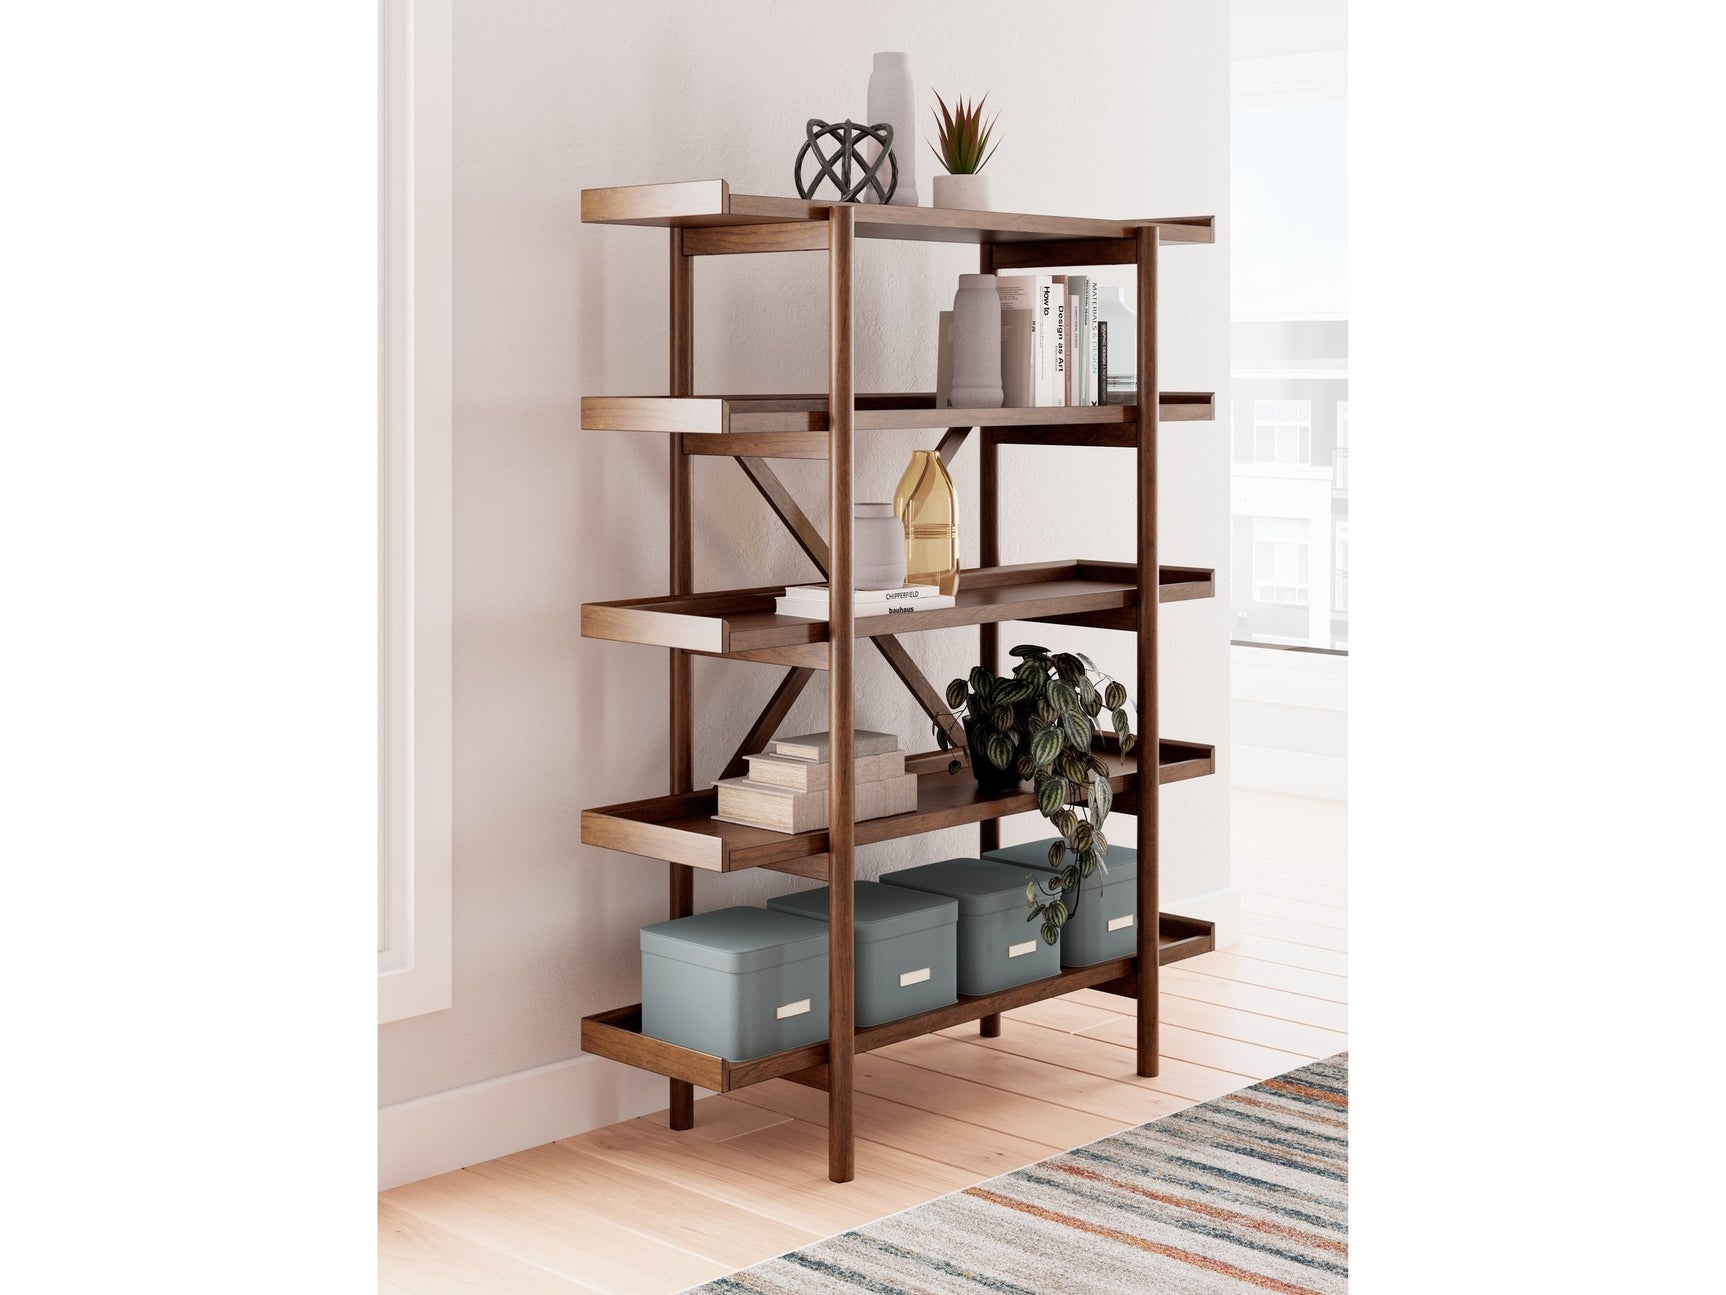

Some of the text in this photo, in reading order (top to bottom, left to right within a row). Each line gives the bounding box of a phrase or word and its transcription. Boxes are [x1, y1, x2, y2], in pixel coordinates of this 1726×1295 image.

[1044, 307, 1050, 316] to
[1058, 343, 1063, 354] as
[886, 591, 919, 600] CHIPPERFIELD
